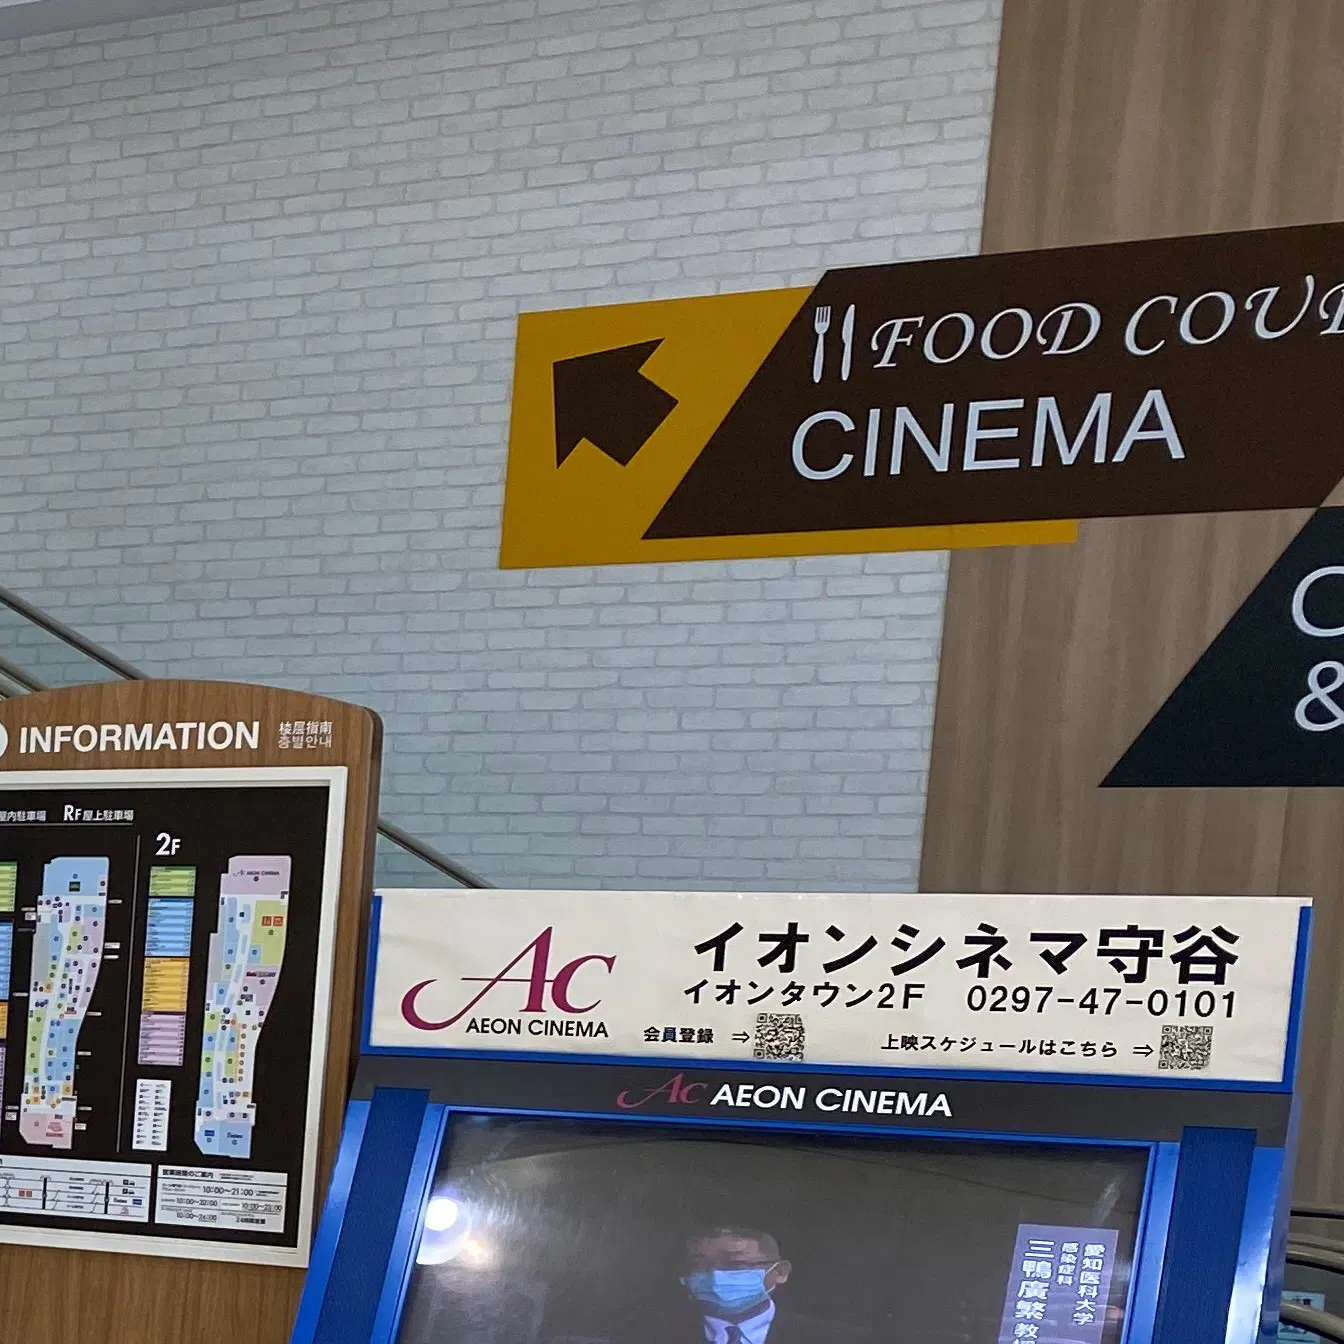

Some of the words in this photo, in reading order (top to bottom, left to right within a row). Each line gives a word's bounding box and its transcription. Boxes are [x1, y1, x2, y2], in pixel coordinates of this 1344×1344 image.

[871, 301, 1102, 368] FOOD
[791, 388, 1187, 482] CINEMA
[19, 721, 260, 755] INFORMATION
[155, 832, 182, 856] 2F
[693, 921, 1240, 986] イオンシネマ守谷
[683, 978, 926, 1010] イオンタウン2F
[966, 984, 1237, 1018] 0297-47-0101
[466, 1017, 522, 1036] AEON
[528, 1019, 609, 1038] CINEMA
[643, 1026, 715, 1045] 会員登録
[881, 1033, 1119, 1059] 上映スケジュールはこちら
[709, 1082, 808, 1110] AEON
[814, 1086, 953, 1117] CINEMA
[1056, 1241, 1080, 1287] 感染症科
[1072, 1243, 1106, 1326] 愛知医科大学
